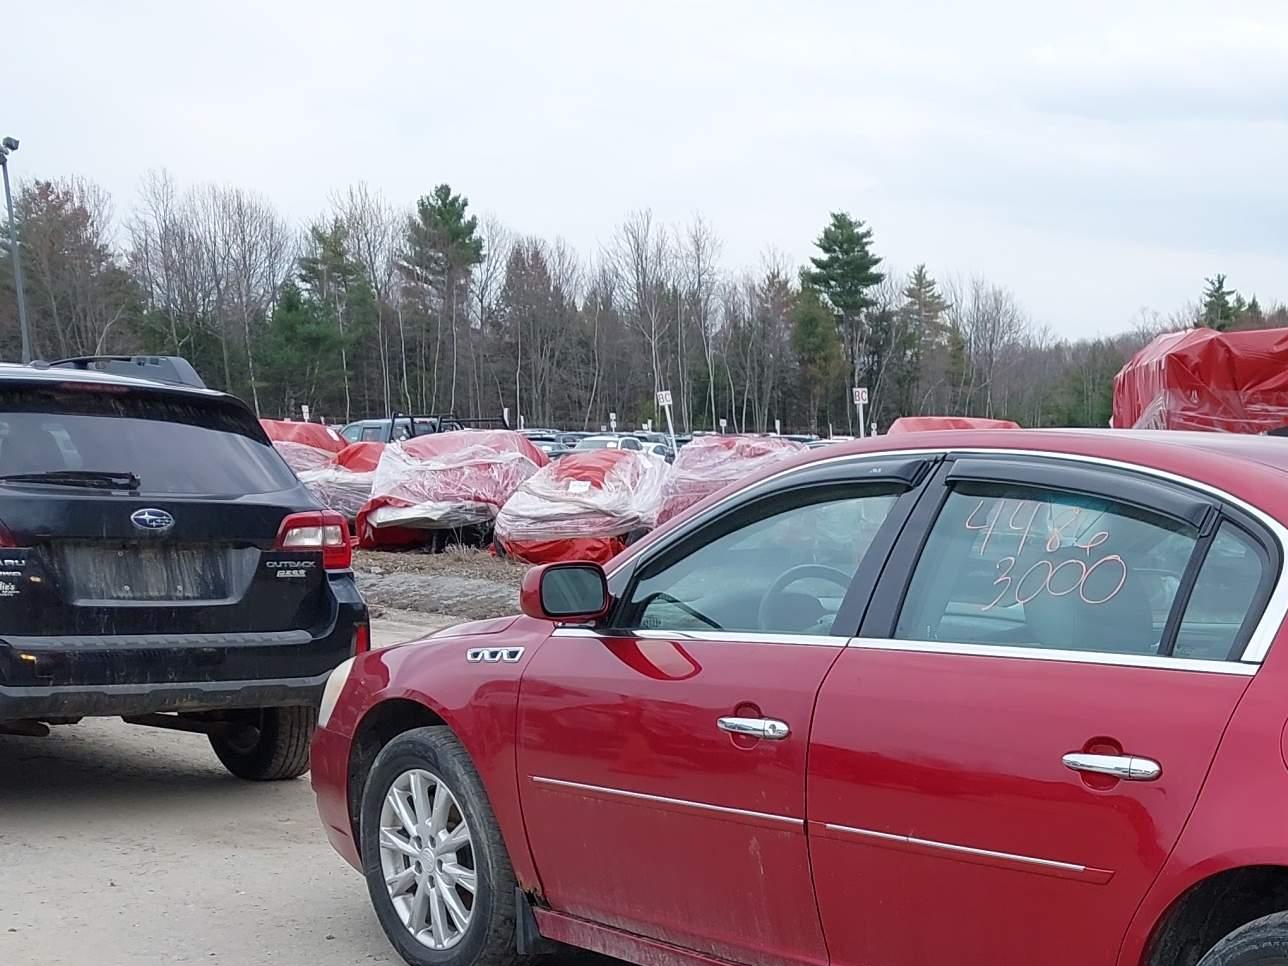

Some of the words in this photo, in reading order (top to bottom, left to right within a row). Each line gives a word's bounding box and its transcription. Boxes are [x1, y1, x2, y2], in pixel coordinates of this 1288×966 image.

[854, 390, 867, 402] BC
[266, 560, 316, 568] OUTBACK
[981, 554, 1127, 611] 3000
